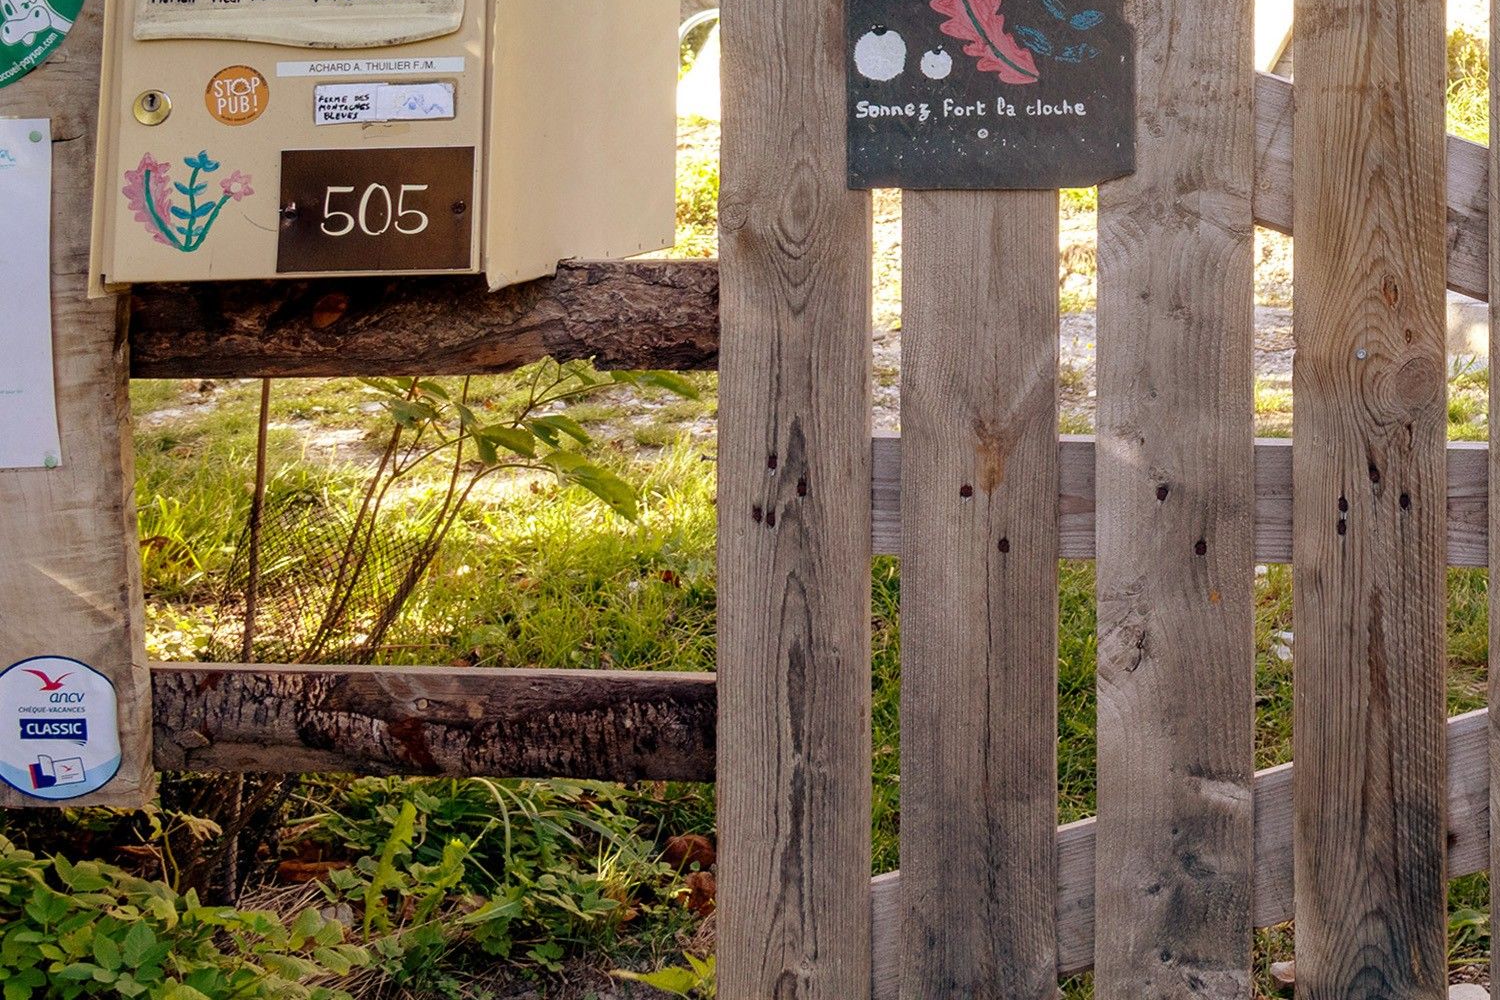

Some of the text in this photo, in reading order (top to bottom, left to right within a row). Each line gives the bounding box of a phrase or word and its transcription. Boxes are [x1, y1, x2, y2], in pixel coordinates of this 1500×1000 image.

[308, 62, 351, 73] ACHARD
[366, 61, 410, 71] THUILIER
[214, 77, 260, 97] STOP
[855, 100, 931, 122] Sonnez
[998, 96, 1016, 117] la
[1026, 99, 1087, 116] cloche
[320, 182, 429, 236] 505
[50, 692, 85, 703] ancv
[26, 723, 82, 735] CLASSIC
